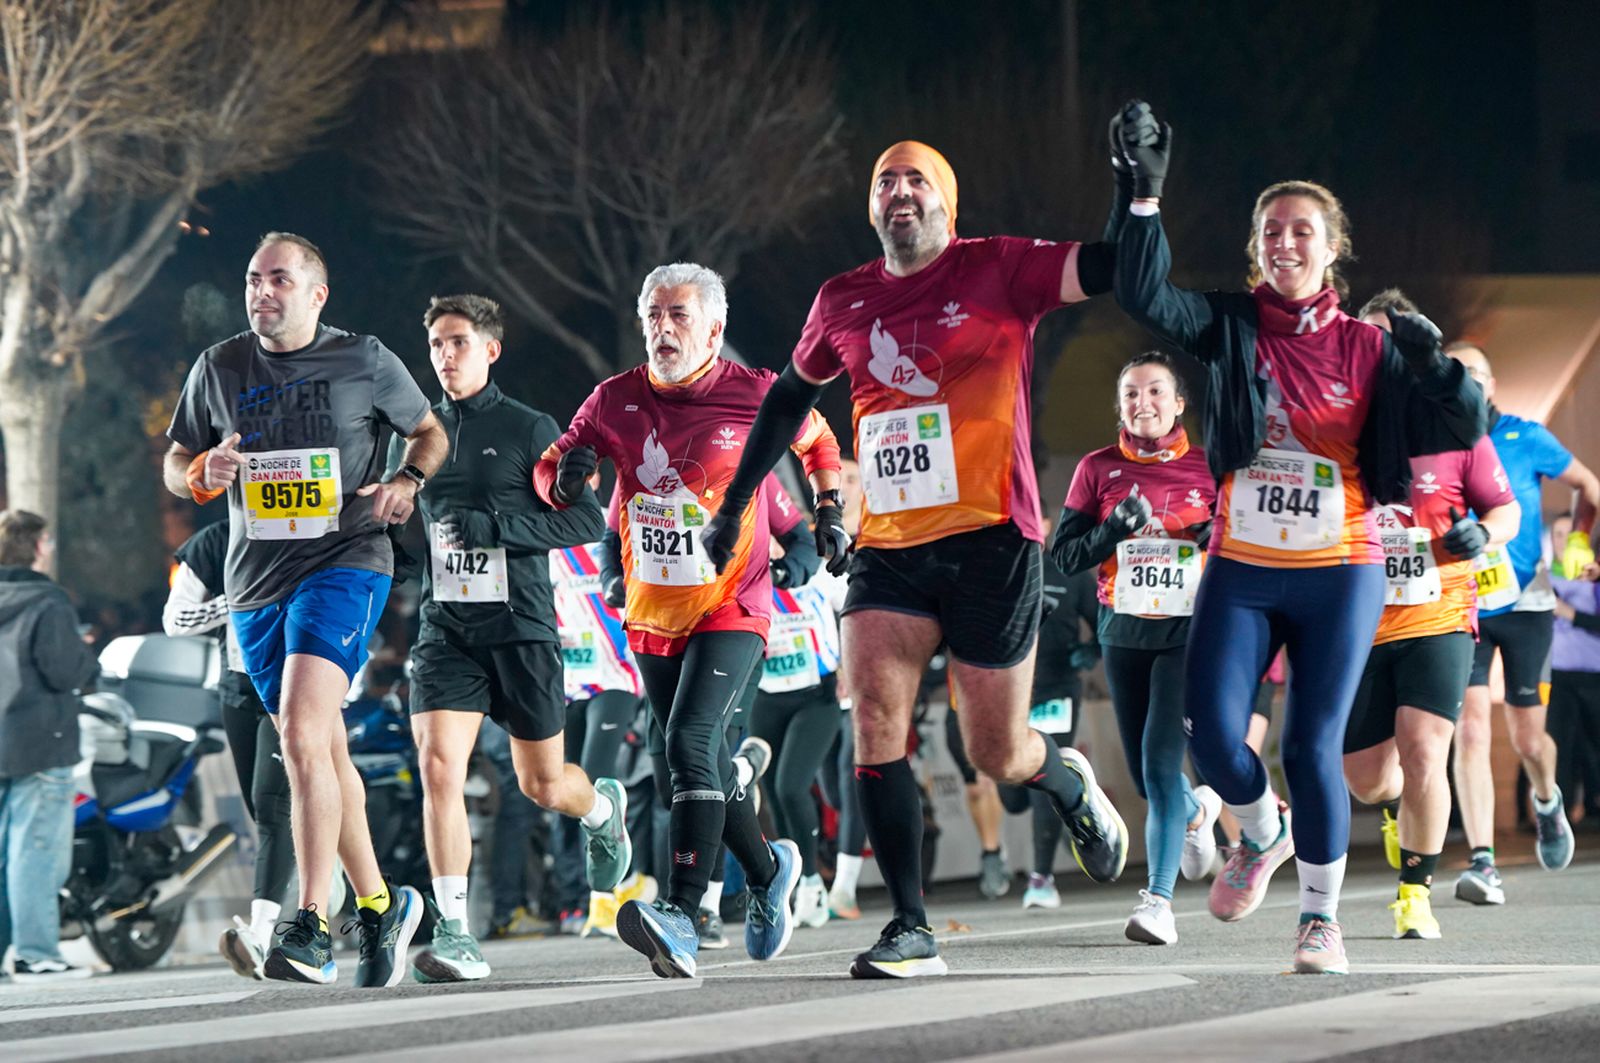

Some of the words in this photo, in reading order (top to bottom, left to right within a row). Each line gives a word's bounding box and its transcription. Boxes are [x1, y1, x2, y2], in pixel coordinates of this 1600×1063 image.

[237, 380, 332, 417] NEVER
[301, 412, 334, 444] UP
[896, 421, 908, 431] DE
[260, 460, 288, 470] NOCHE
[290, 460, 301, 469] DE
[874, 444, 930, 478] 1328
[1292, 463, 1305, 473] DE
[250, 472, 270, 482] SAN
[272, 470, 303, 481] ANTÓN
[1247, 469, 1267, 481] SAN
[1269, 471, 1304, 486] ANTÓN
[261, 481, 321, 509] 9575
[1256, 484, 1320, 518] 1844
[636, 513, 649, 525] SAN
[649, 515, 675, 528] ANTÓN
[644, 505, 665, 516] NOCHE
[641, 526, 694, 556] 5321
[1136, 547, 1160, 555] NOCHE
[1161, 547, 1171, 555] DE
[445, 552, 489, 575] 4742
[1128, 557, 1142, 565] SAN
[1143, 555, 1171, 564] ANTÓN
[1385, 556, 1425, 579] 643
[1131, 565, 1185, 589] 3644
